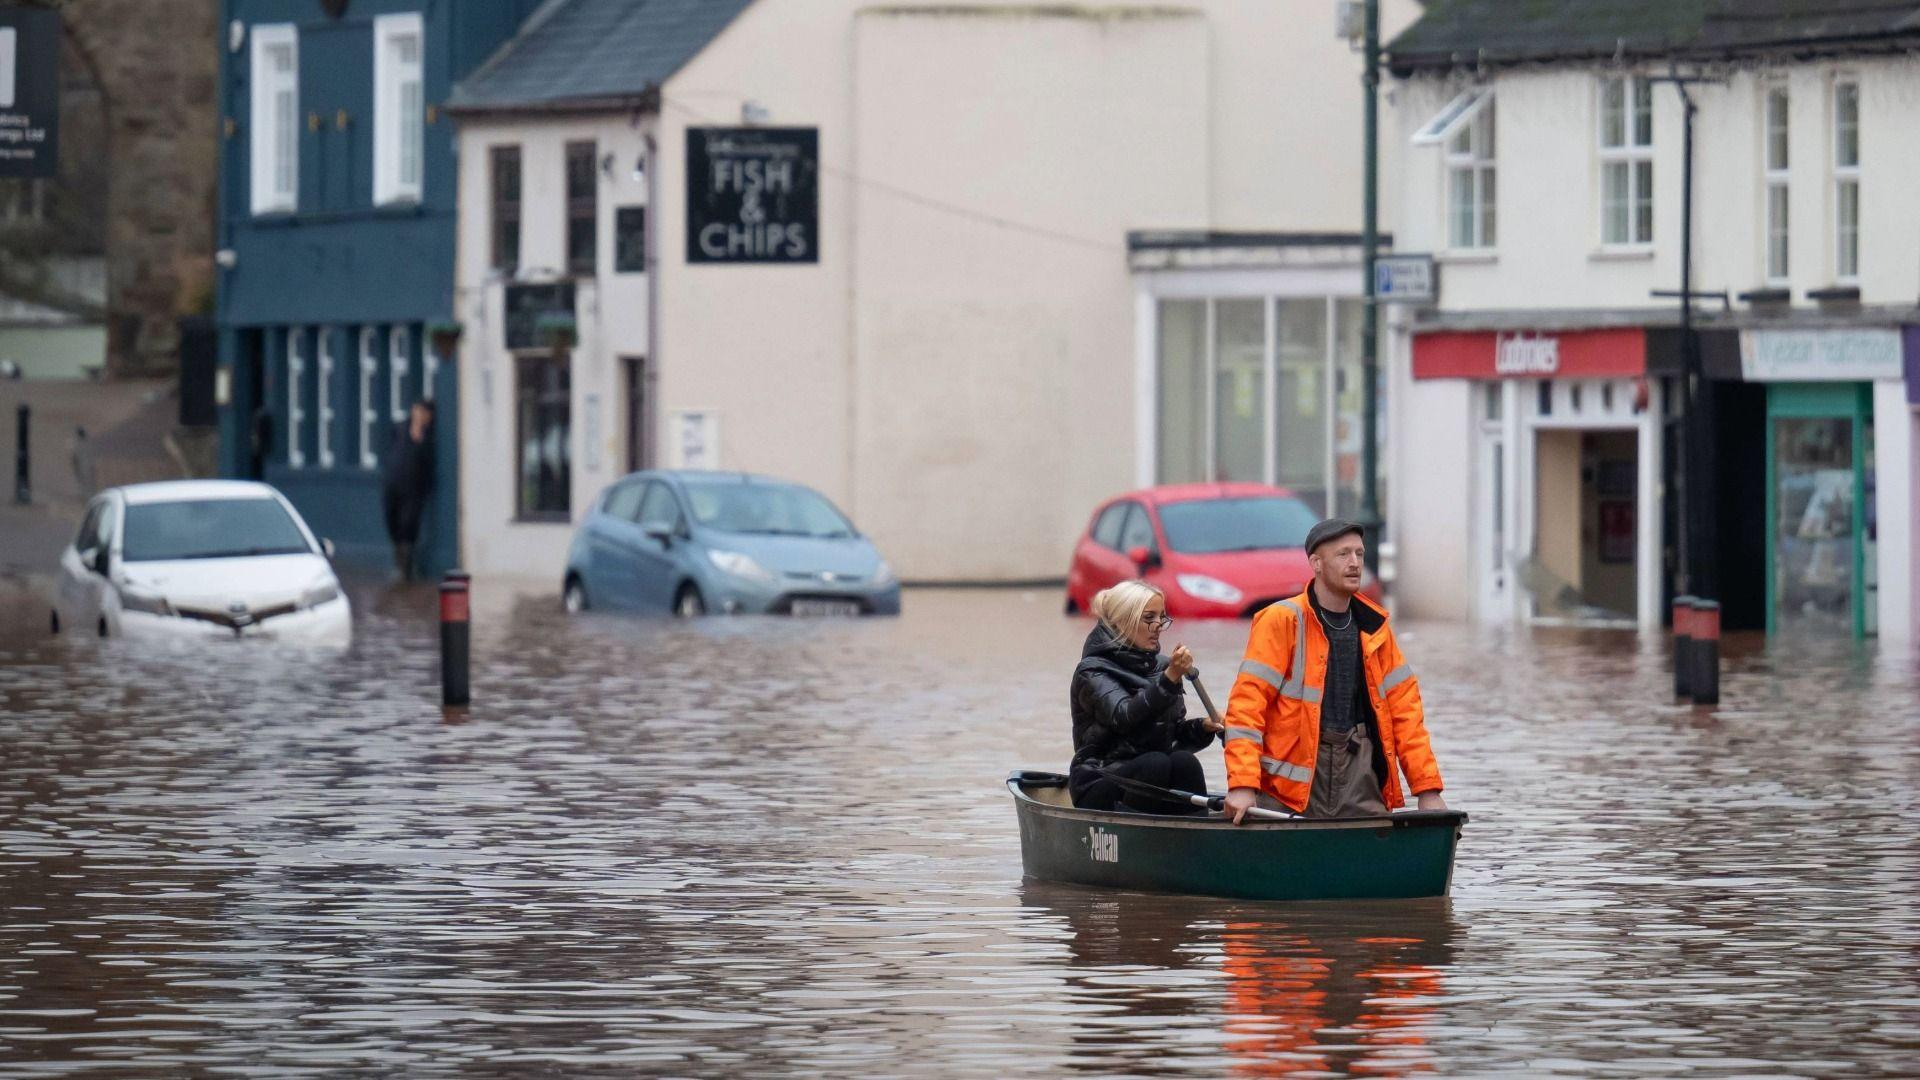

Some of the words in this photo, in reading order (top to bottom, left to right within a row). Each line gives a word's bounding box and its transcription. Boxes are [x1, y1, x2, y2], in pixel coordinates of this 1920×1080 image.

[714, 160, 792, 193] FISH
[739, 188, 766, 224] &
[699, 222, 808, 258] CHIPS
[1089, 826, 1119, 862] Pelican
